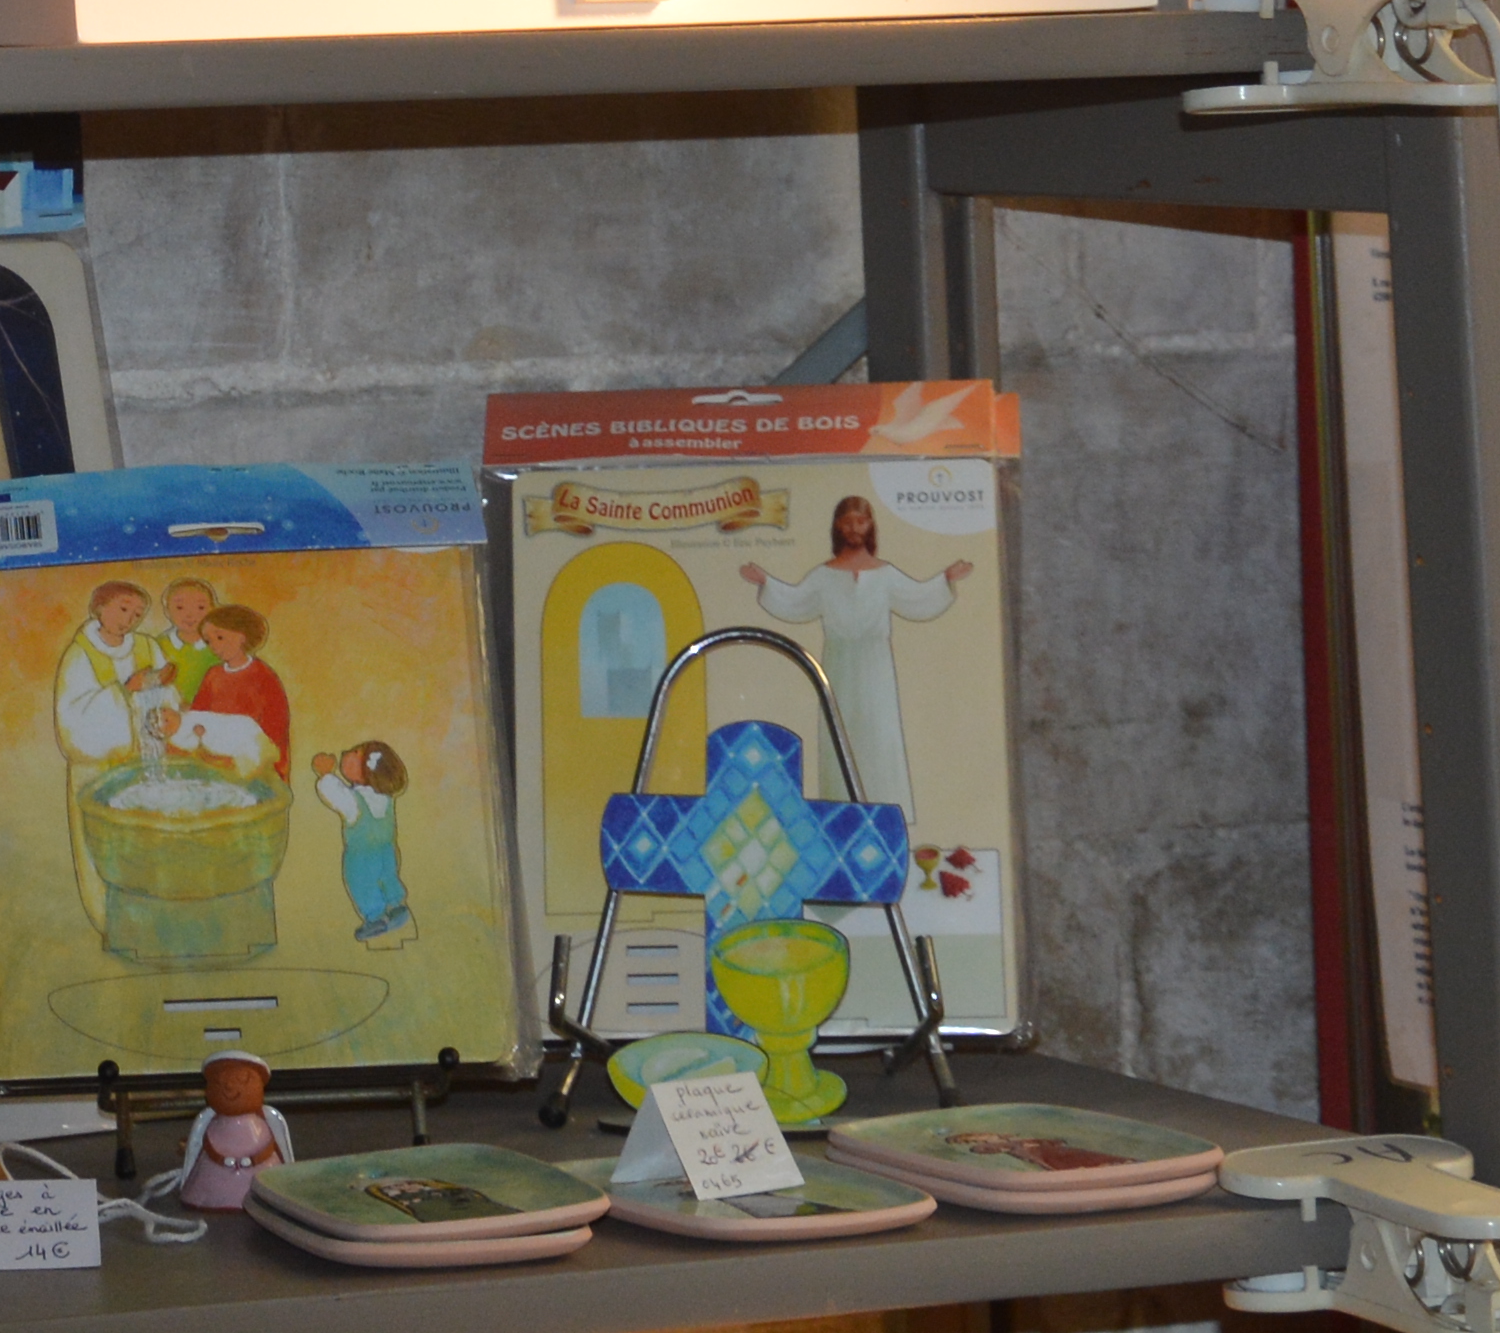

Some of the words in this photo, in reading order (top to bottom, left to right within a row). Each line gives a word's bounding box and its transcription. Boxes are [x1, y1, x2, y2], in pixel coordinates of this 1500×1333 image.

[501, 420, 601, 441] SCÈNES
[610, 418, 747, 435] BIBLIQUES
[755, 416, 789, 433] DE
[797, 415, 860, 432] BOIS
[642, 436, 743, 450] assembler
[558, 487, 580, 511] La
[585, 495, 643, 521] Sainte
[649, 486, 756, 521] Communion
[897, 489, 985, 504] PROUVOST
[374, 502, 472, 516] PROUVOST
[675, 1083, 742, 1106] plaque
[41, 1183, 56, 1200] à
[31, 1206, 63, 1217] en
